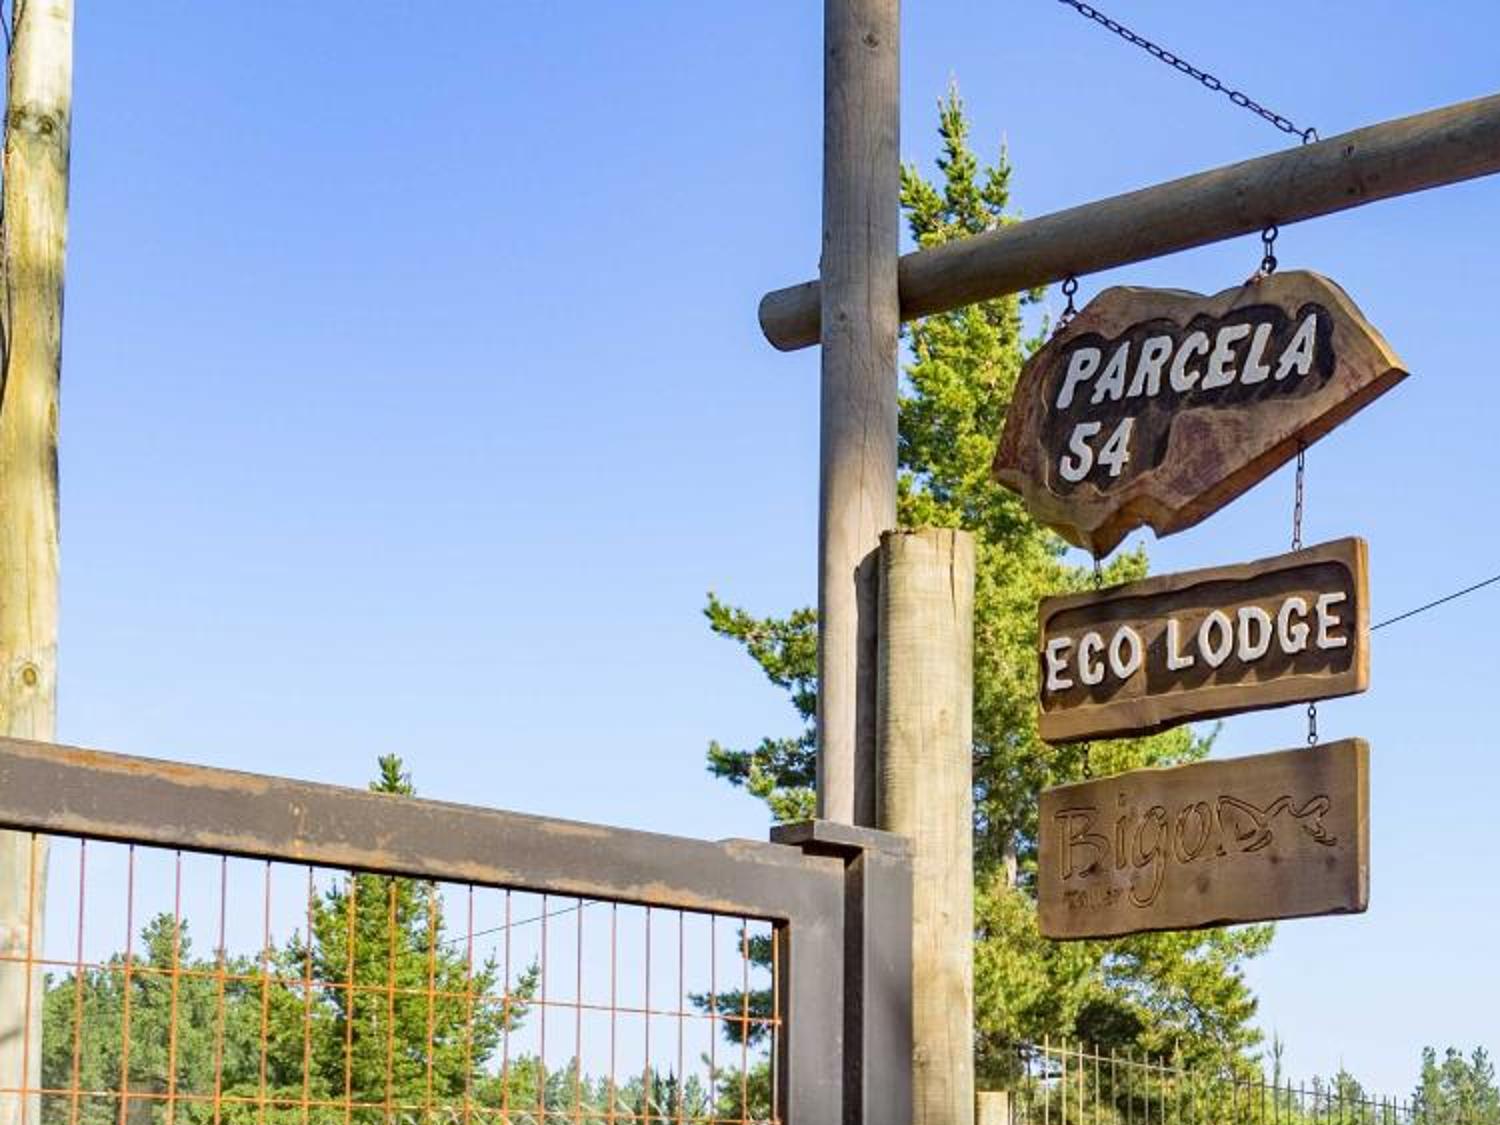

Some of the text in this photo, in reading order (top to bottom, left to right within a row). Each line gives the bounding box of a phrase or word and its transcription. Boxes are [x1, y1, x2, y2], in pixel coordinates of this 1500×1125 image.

[1055, 313, 1317, 410] PARCELA
[1059, 416, 1136, 482] 54
[1045, 591, 1348, 692] ECO LODGE
